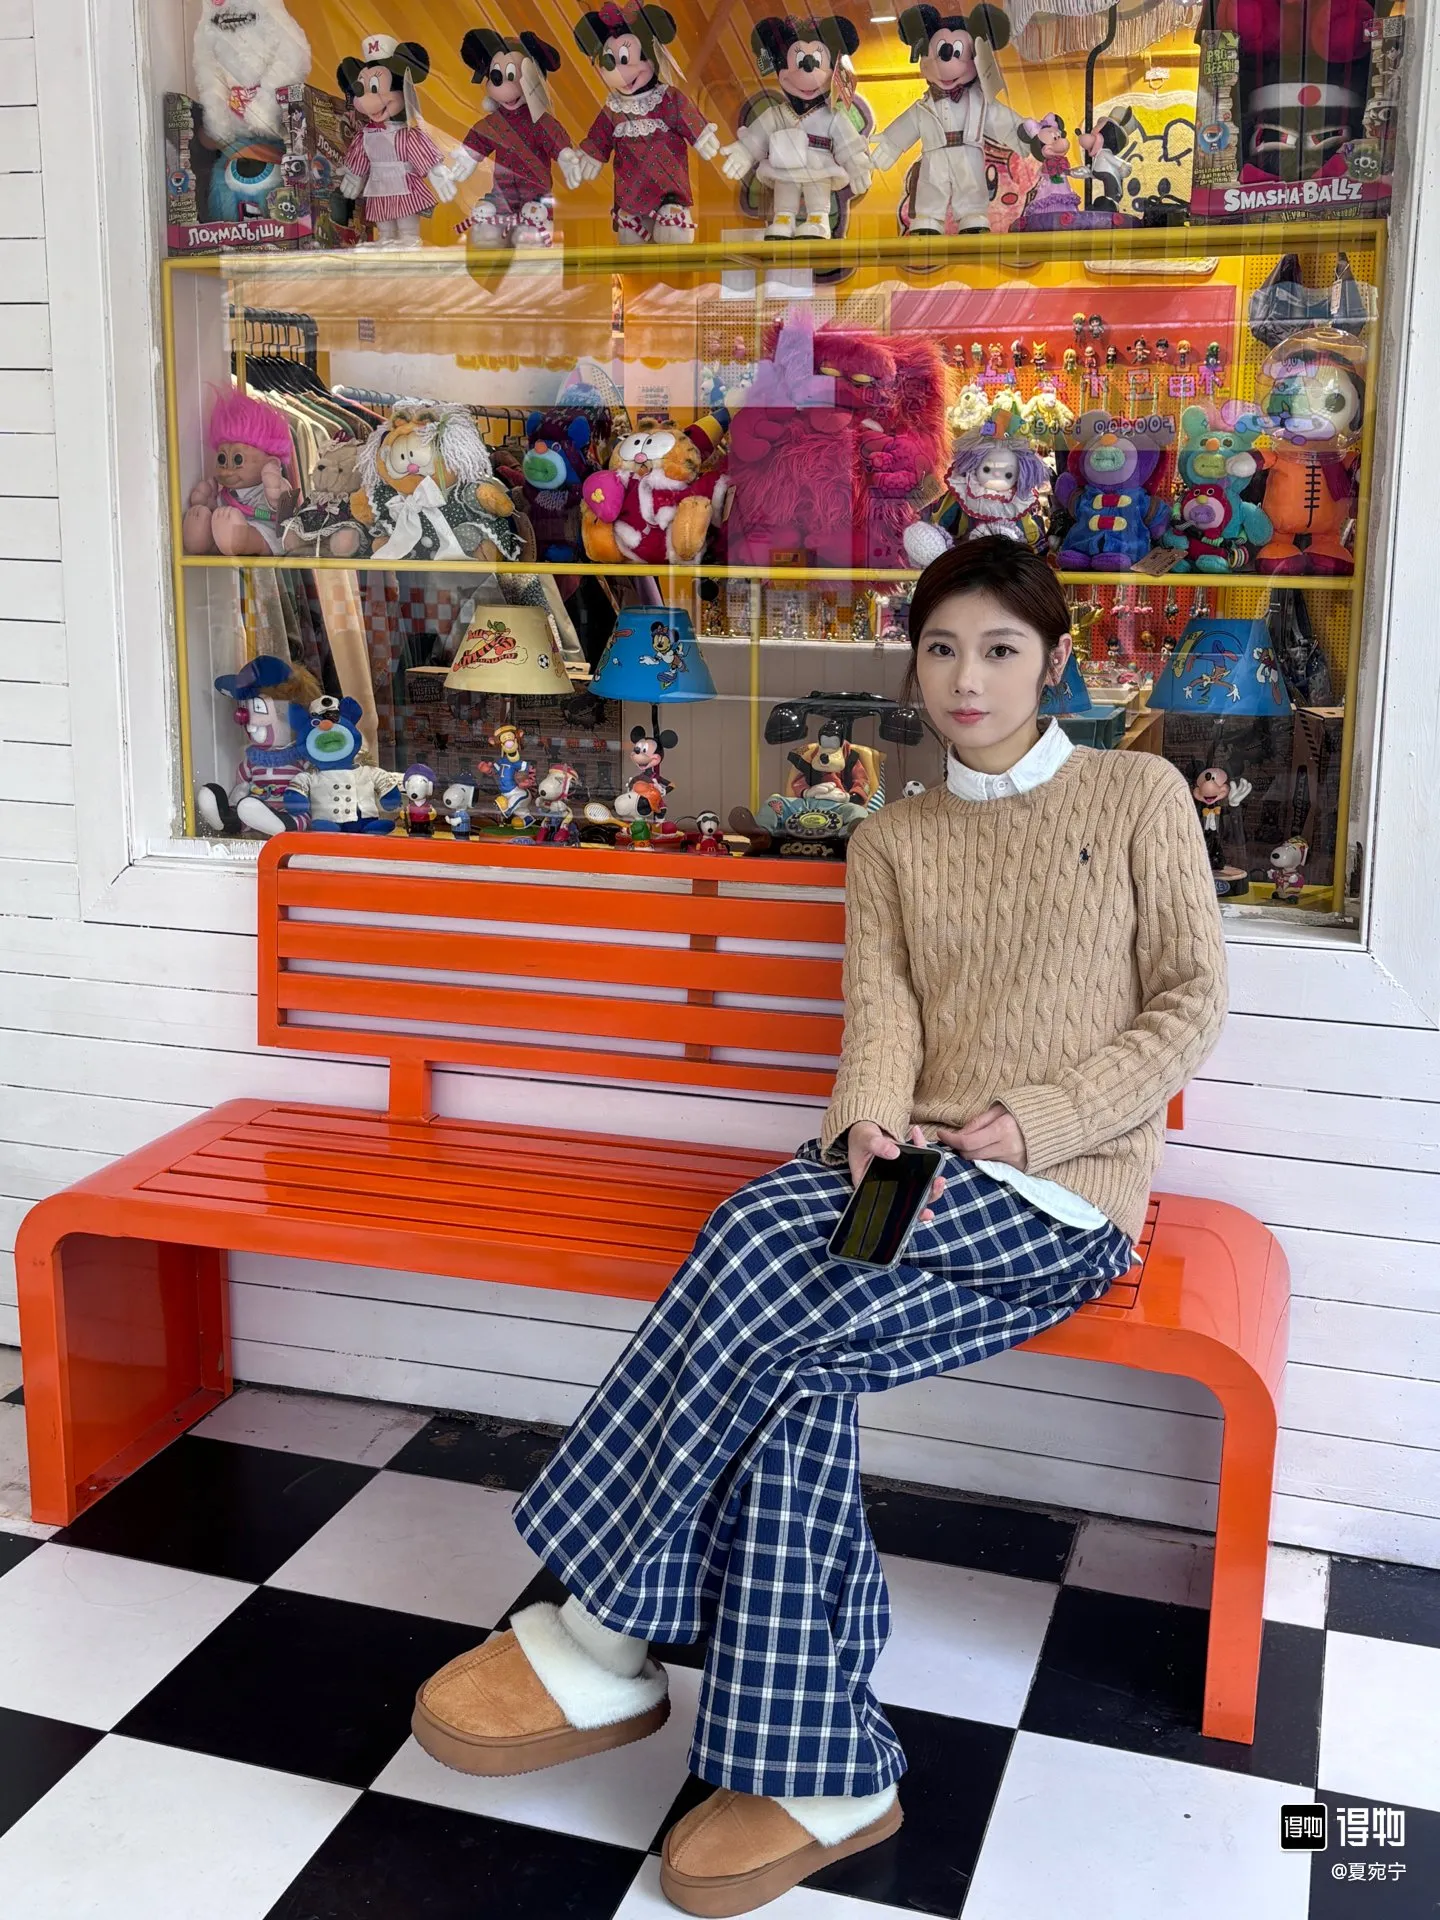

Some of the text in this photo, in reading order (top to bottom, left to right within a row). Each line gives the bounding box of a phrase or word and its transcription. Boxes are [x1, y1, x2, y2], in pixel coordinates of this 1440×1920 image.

[368, 40, 379, 54] M
[188, 223, 285, 246] ЛОХМАТЫШИ
[500, 763, 511, 778] T
